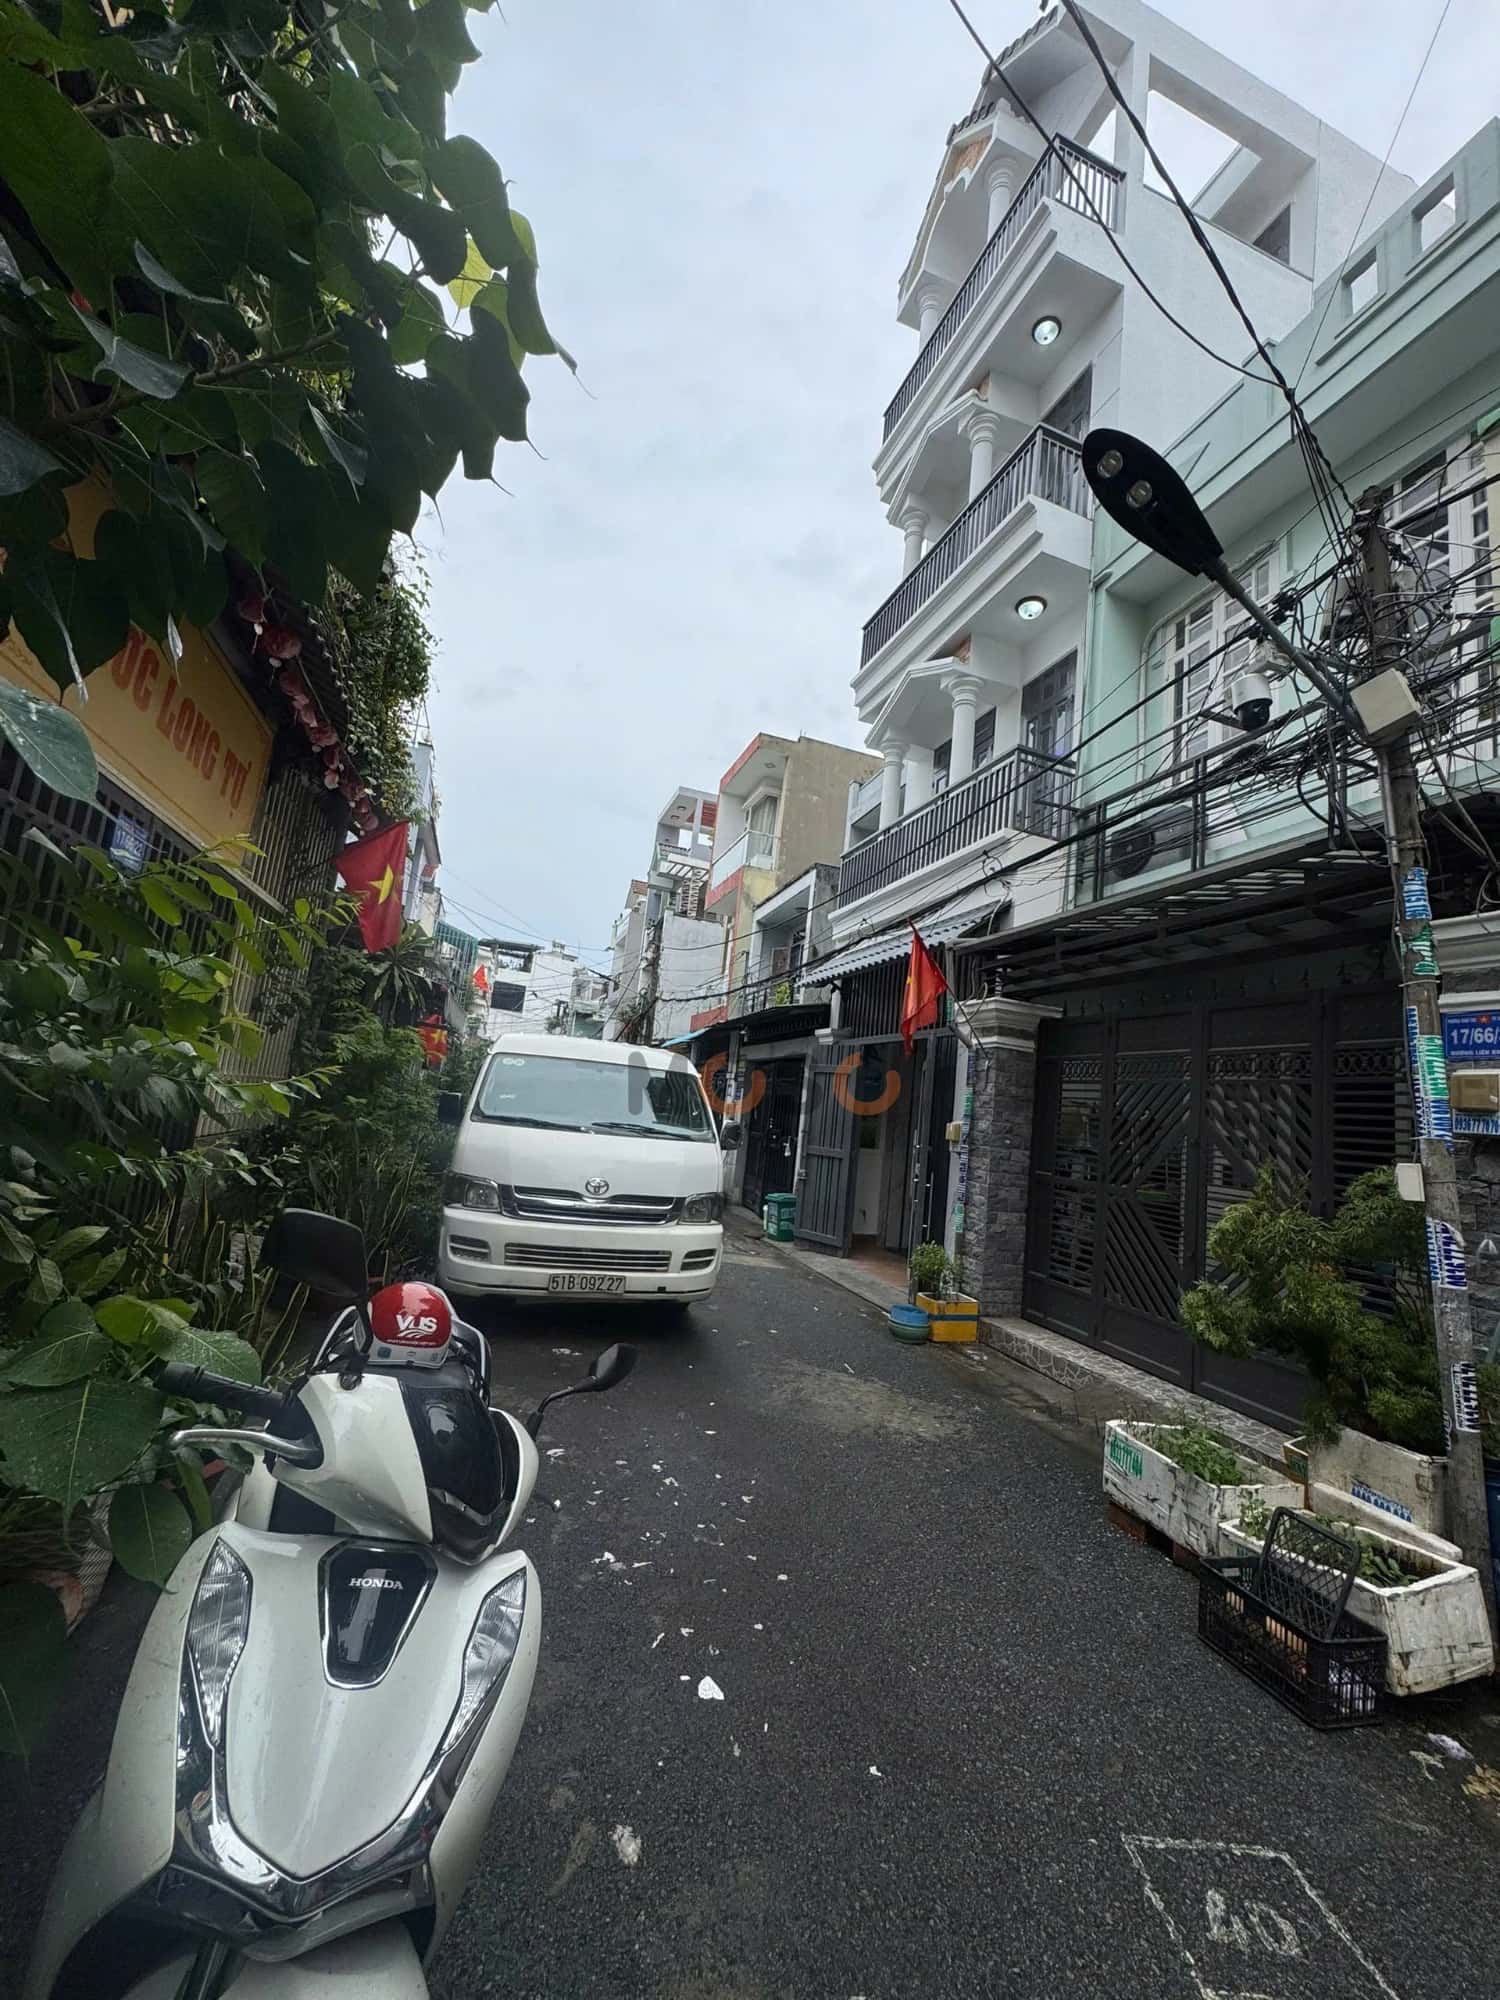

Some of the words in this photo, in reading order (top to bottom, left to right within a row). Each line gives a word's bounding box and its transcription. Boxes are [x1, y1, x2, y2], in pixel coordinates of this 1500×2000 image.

[156, 676, 222, 781] LONG
[1450, 1026, 1500, 1046] 17/66/
[395, 1314, 438, 1333] VUS
[348, 1577, 404, 1591] HONDA
